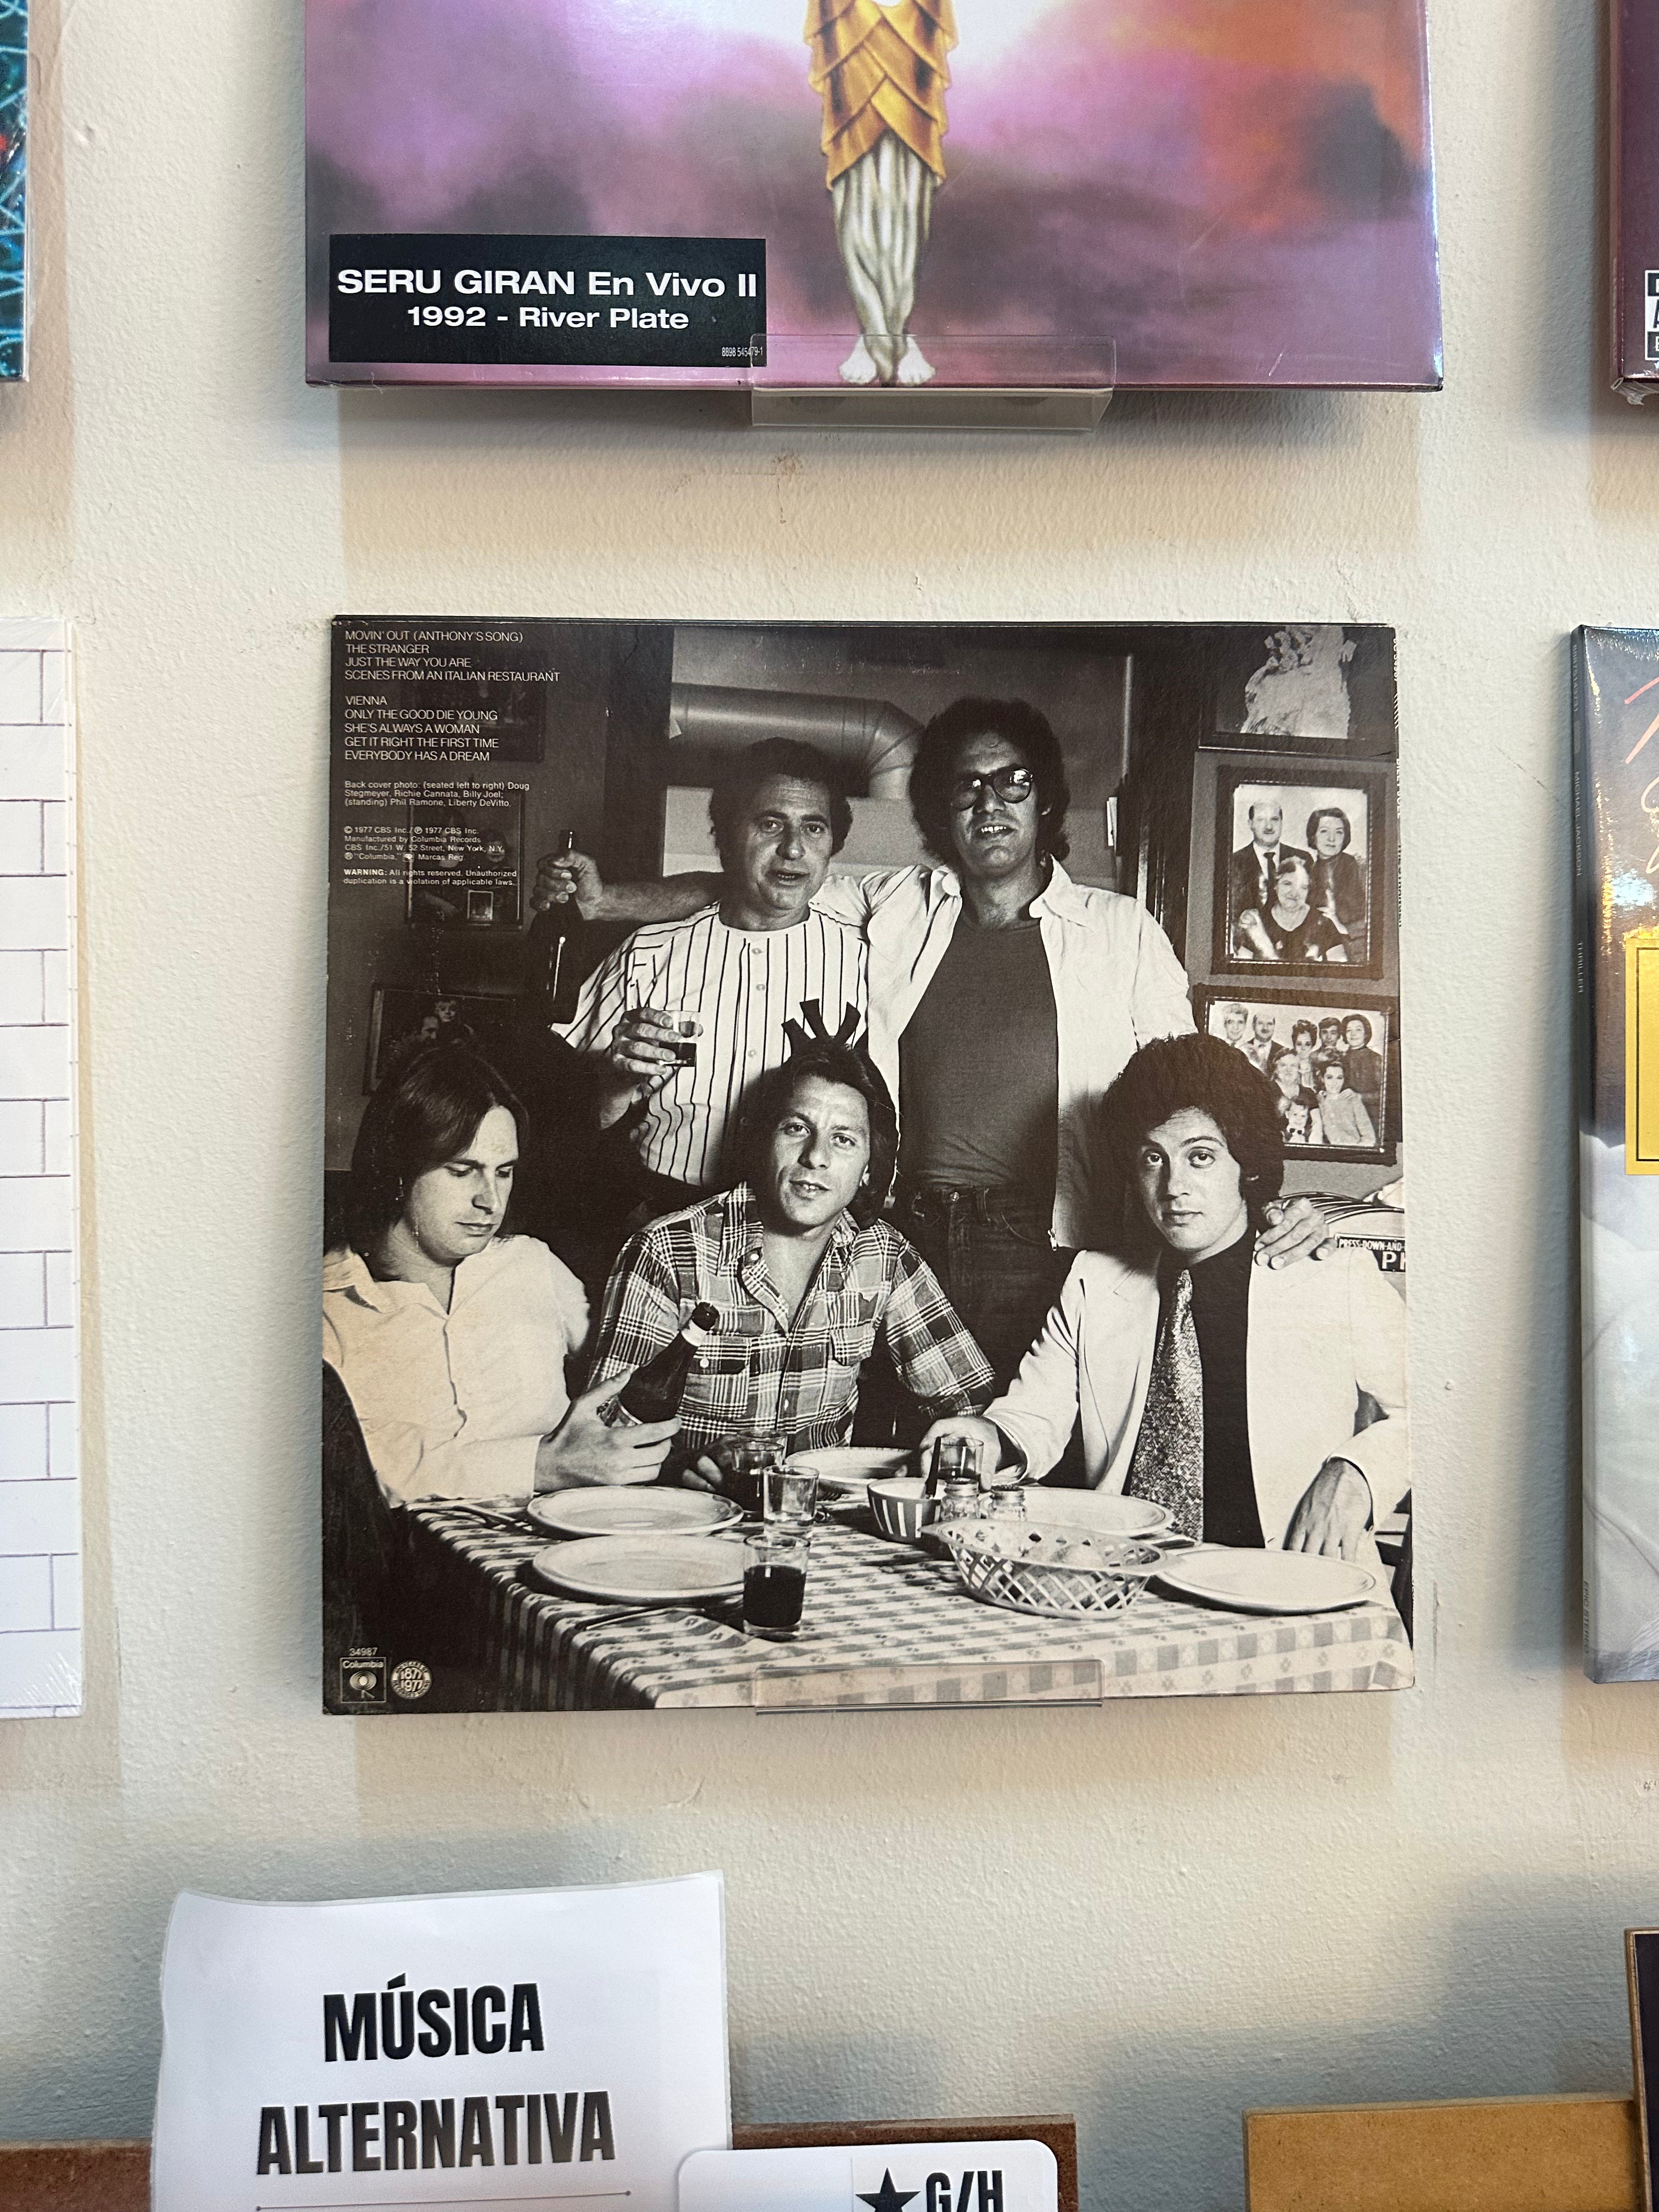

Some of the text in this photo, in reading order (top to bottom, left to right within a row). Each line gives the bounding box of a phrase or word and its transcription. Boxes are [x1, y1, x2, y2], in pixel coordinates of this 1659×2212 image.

[337, 269, 757, 297] SERU GIRAN En Vivo II
[408, 306, 486, 326] 1992
[520, 307, 599, 328] River
[610, 308, 689, 329] Plate
[386, 631, 410, 641] OUT
[414, 631, 483, 642] (ANTHONY'S
[485, 631, 523, 643] SONG)
[346, 644, 430, 653] THE STRANGER
[345, 657, 472, 667] JUST THE WAY YOU ARE
[345, 670, 561, 681] SCENES FROM AN ITALIAN RESTAURANT
[345, 695, 388, 706] VIENNA
[345, 709, 498, 720] ONLY THE GOOD DIE YOUNG
[345, 723, 480, 733] SHE'S ALWAYS A WOMAN
[345, 737, 500, 748] GET IT RIGHT THE FIRST TIME
[345, 751, 490, 761] EVERYBODY HAS A DREAM
[423, 781, 454, 789] (seated
[482, 782, 505, 791] right)
[507, 782, 530, 791] Doug
[463, 791, 482, 799] Billy
[345, 798, 388, 807] (standing)
[448, 799, 477, 808] Liberty
[349, 1647, 378, 1656] 34987
[342, 1660, 383, 1669] Columbia
[400, 1667, 422, 1679] 1877
[400, 1679, 423, 1691] 1977
[323, 1972, 544, 2062] MÚSICA
[256, 2091, 615, 2175] ALTERNATIVA
[926, 2170, 1003, 2212] G/H
